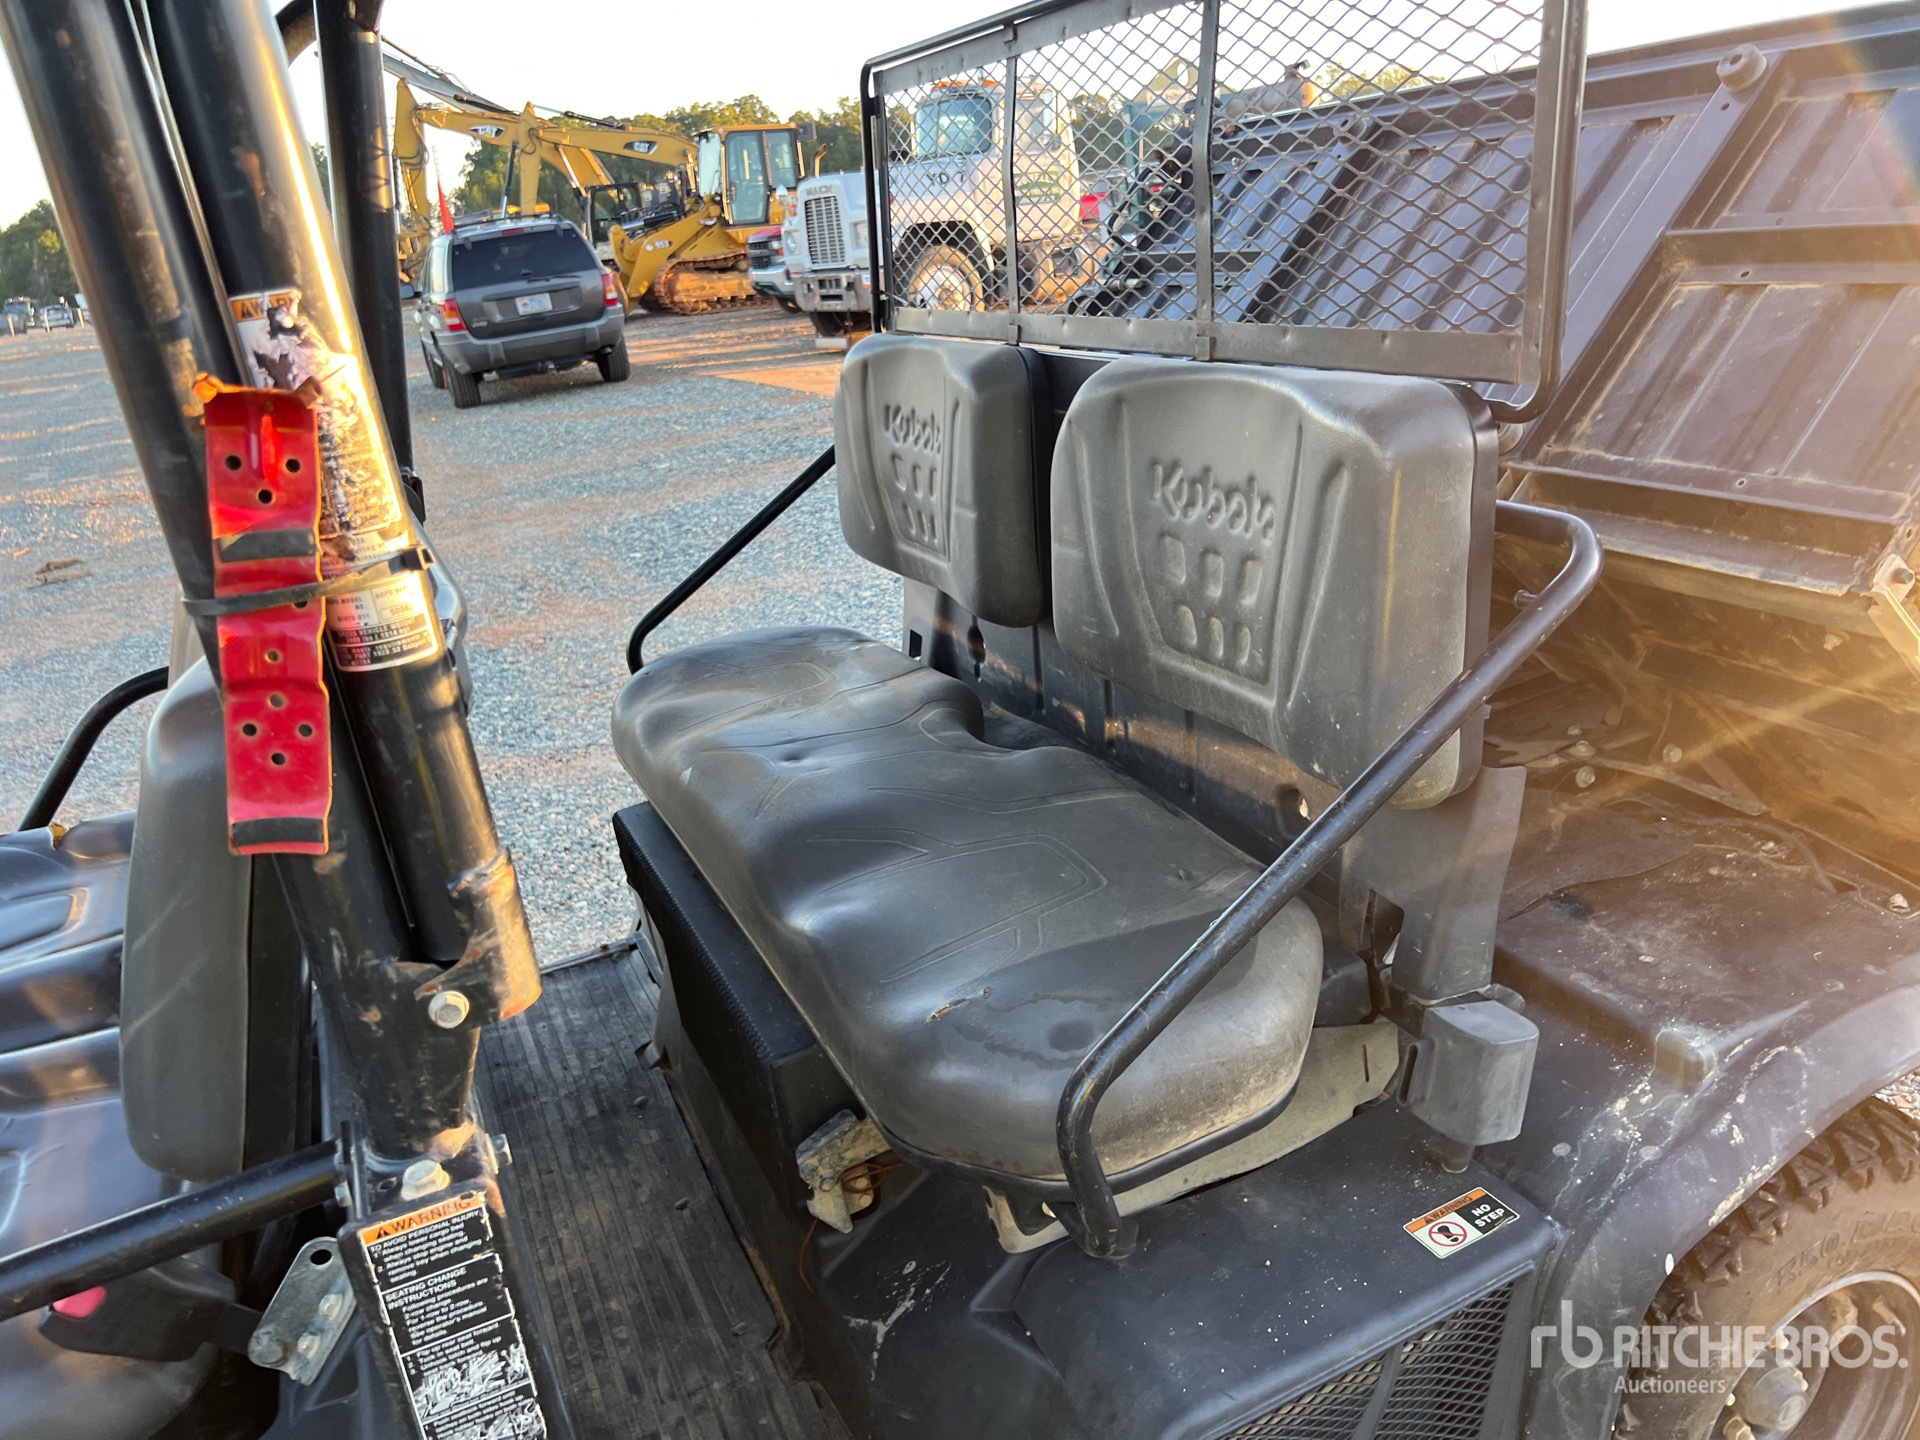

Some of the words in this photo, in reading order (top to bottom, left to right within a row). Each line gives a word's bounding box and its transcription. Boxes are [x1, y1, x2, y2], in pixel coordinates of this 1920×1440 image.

[882, 402, 942, 456] Kubota
[1151, 459, 1277, 546] Kubota
[390, 1199, 469, 1231] WARNING
[1430, 1195, 1474, 1221] WARNING
[1471, 1204, 1491, 1216] NO
[1474, 1208, 1505, 1227] STEP
[370, 1244, 381, 1252] TO
[384, 1236, 407, 1248] AVOID
[408, 1221, 450, 1239] PERSONAL
[451, 1210, 480, 1223] INJURY
[386, 1282, 425, 1302] SEATING
[428, 1267, 466, 1286] CHANGE
[388, 1280, 456, 1310] INSTRUCTIONS
